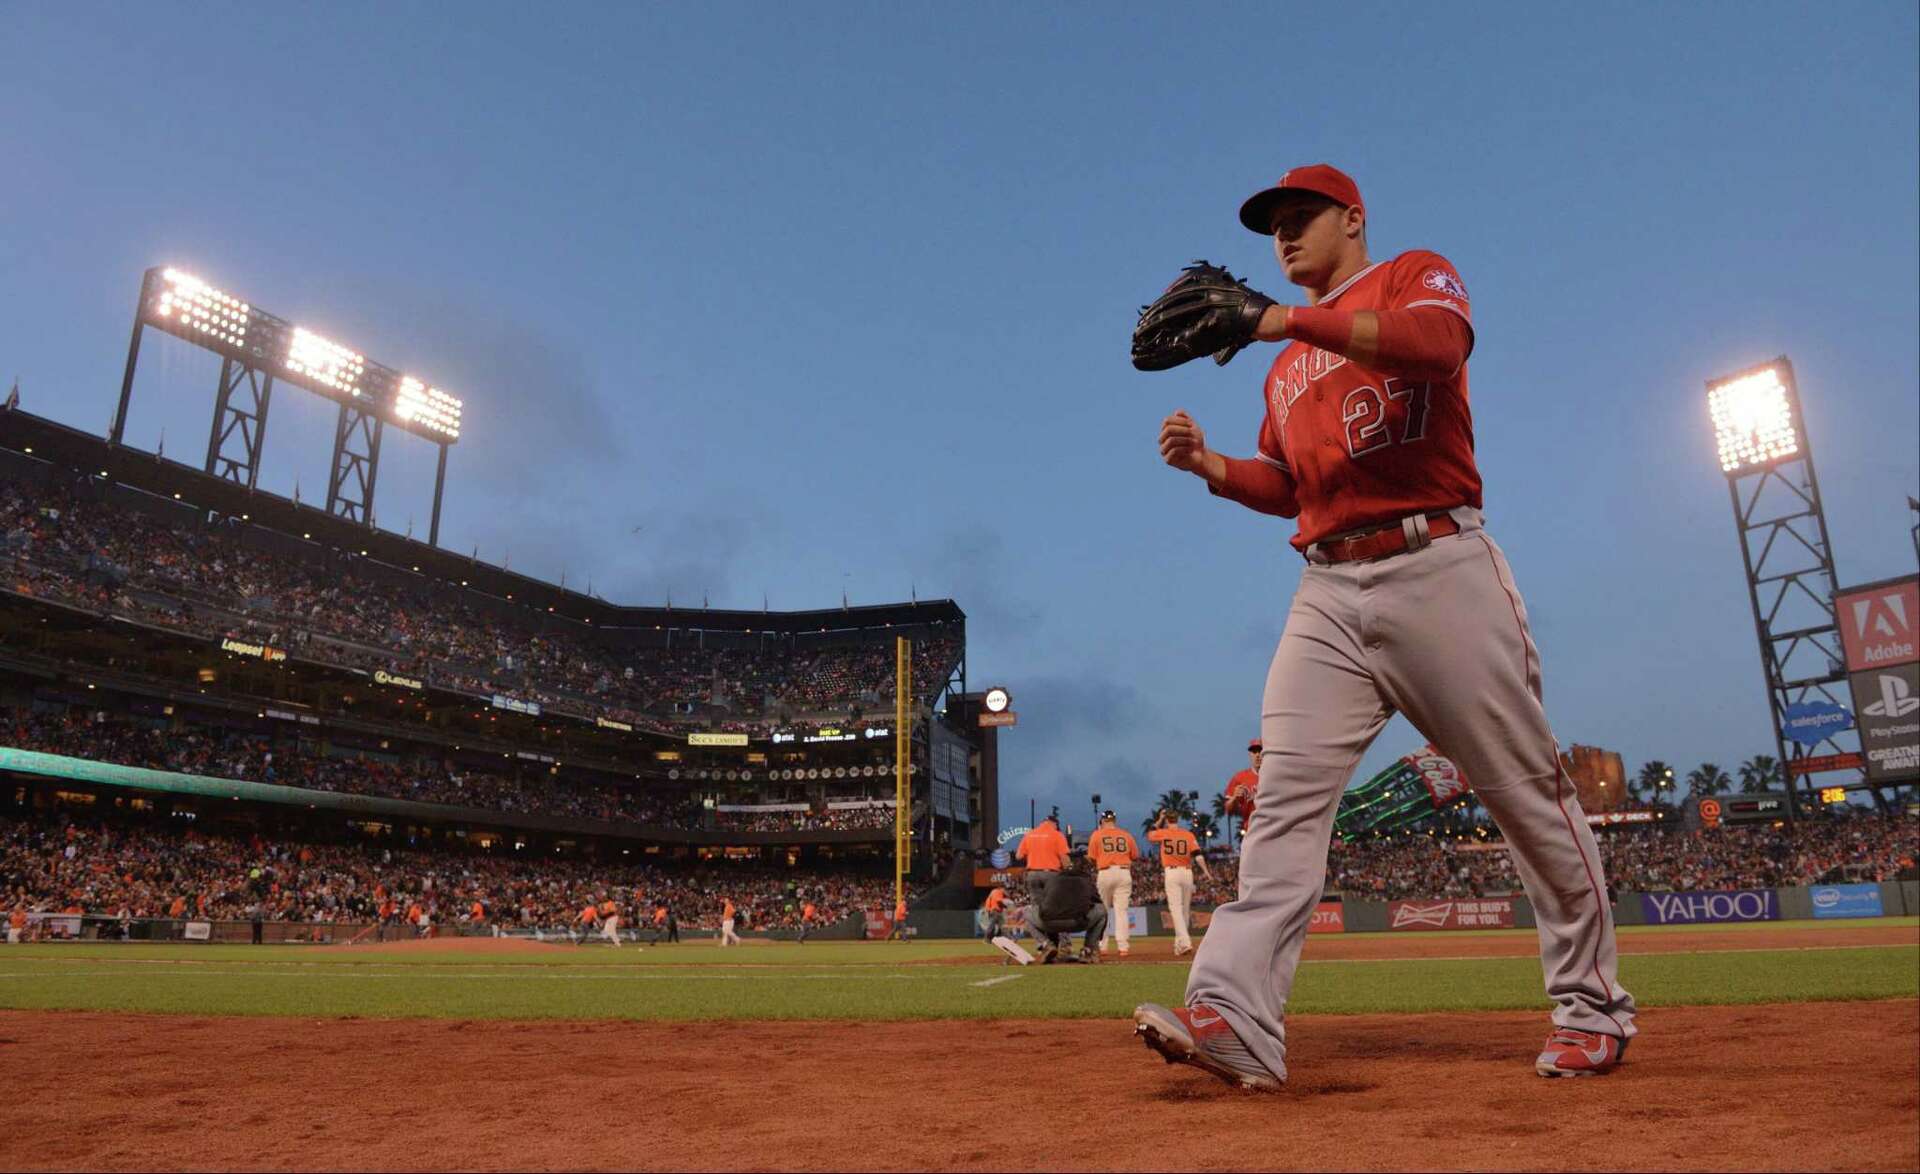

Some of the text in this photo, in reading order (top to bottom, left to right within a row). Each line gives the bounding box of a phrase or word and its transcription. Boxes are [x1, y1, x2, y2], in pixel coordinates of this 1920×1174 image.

[1343, 376, 1431, 459] 27
[1864, 643, 1914, 662] Adobe
[1791, 713, 1844, 728] salesforce
[1102, 837, 1127, 853] 58
[1163, 839, 1188, 855] 50
[1456, 902, 1511, 913] THIS BUD'S
[1650, 891, 1770, 923] YAHOO!
[1457, 914, 1477, 925] FOR
